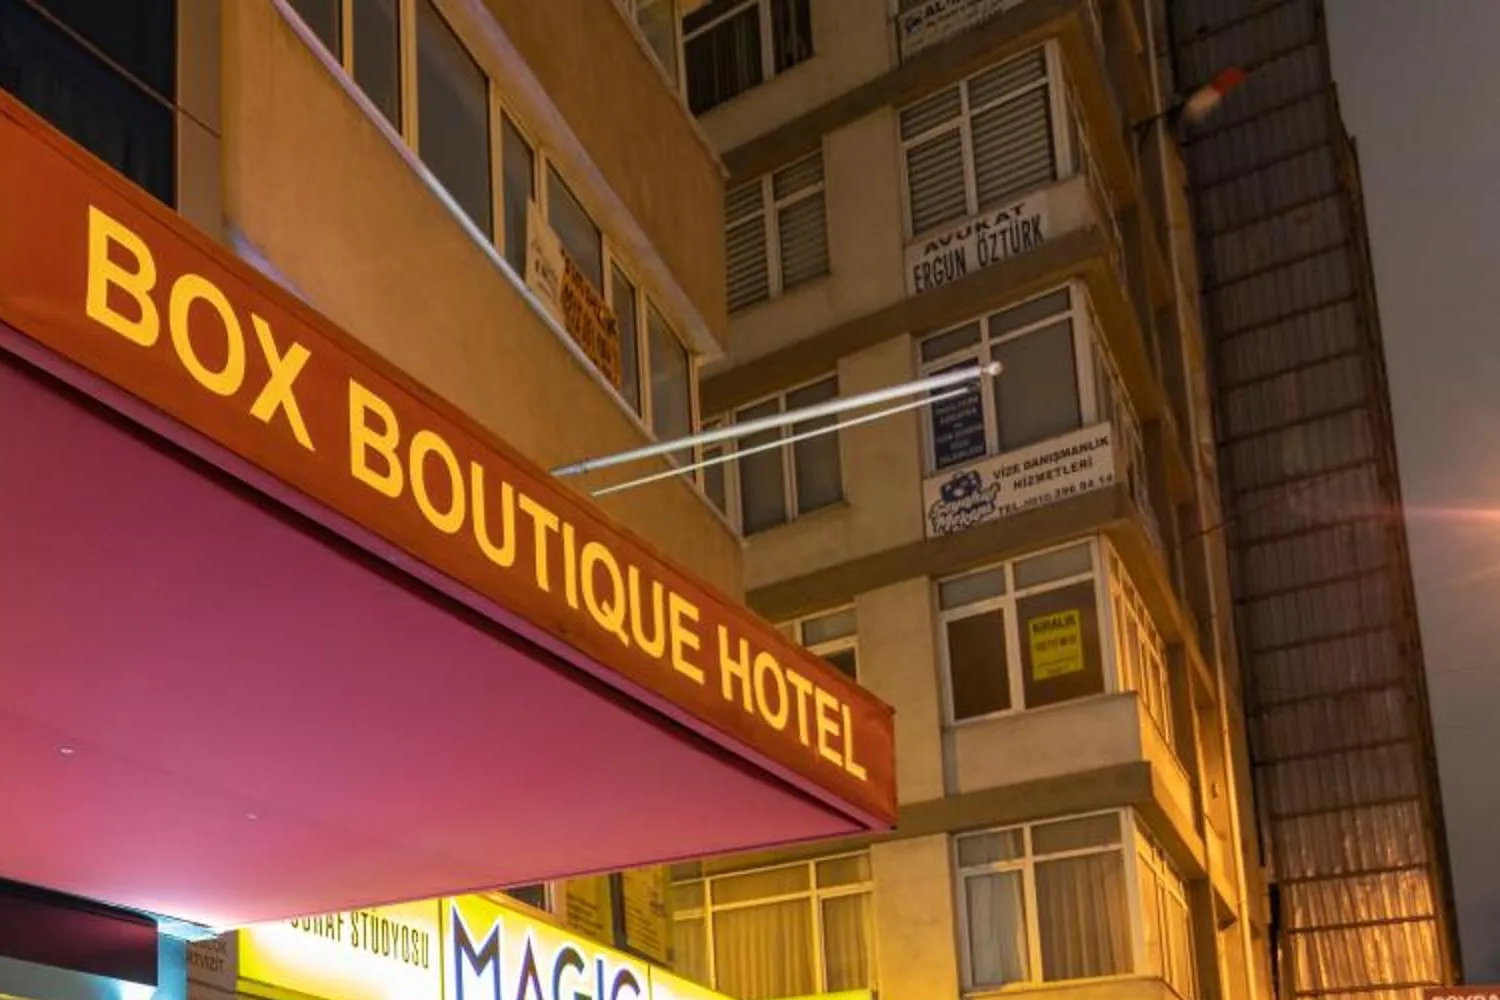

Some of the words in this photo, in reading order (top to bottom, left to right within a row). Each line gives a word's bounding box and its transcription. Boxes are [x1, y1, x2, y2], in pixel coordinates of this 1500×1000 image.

[924, 203, 1026, 255] AVUKAT
[977, 213, 1045, 268] ÖZTÜRK
[86, 205, 314, 452] BOX
[349, 378, 705, 685] BOUTIQUE
[717, 625, 867, 781] HOTEL
